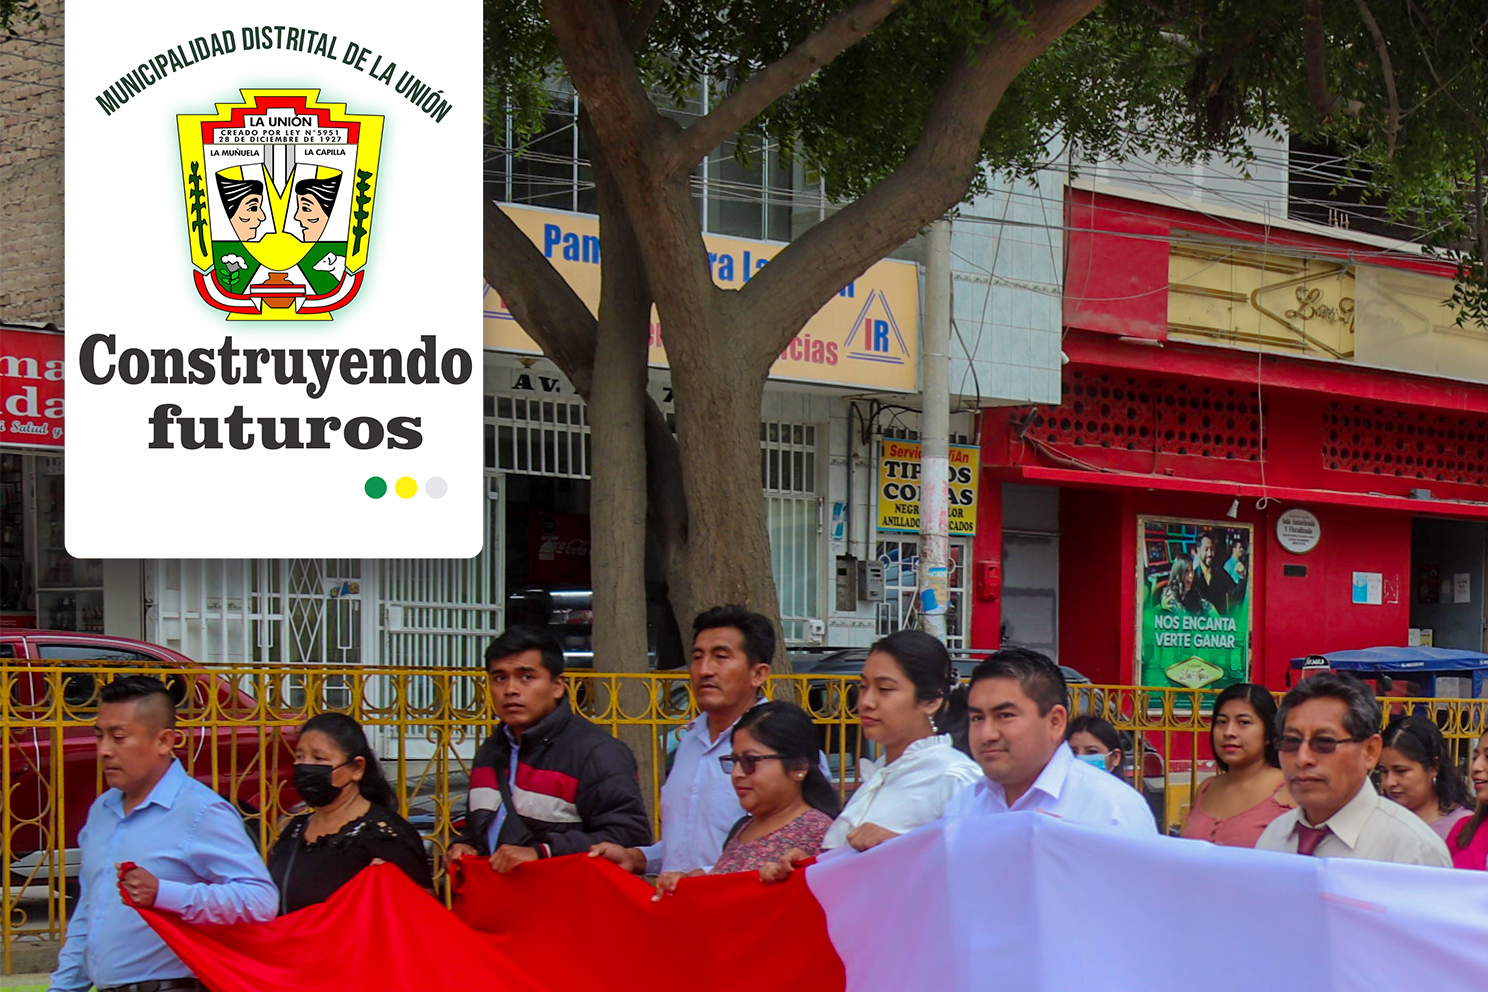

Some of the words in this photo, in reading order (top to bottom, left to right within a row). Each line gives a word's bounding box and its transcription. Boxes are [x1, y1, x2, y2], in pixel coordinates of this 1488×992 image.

[865, 318, 889, 352] IR
[0, 385, 65, 419] da
[11, 420, 48, 436] Salud
[889, 444, 922, 459] Servi
[895, 503, 920, 515] NEGR
[882, 516, 920, 528] ANILLADO
[948, 520, 974, 532] CADOS
[1154, 615, 1180, 631] NOS
[1182, 616, 1236, 632] ENCANTA
[1155, 632, 1191, 648] VERTE
[1193, 634, 1235, 649] GANAR
